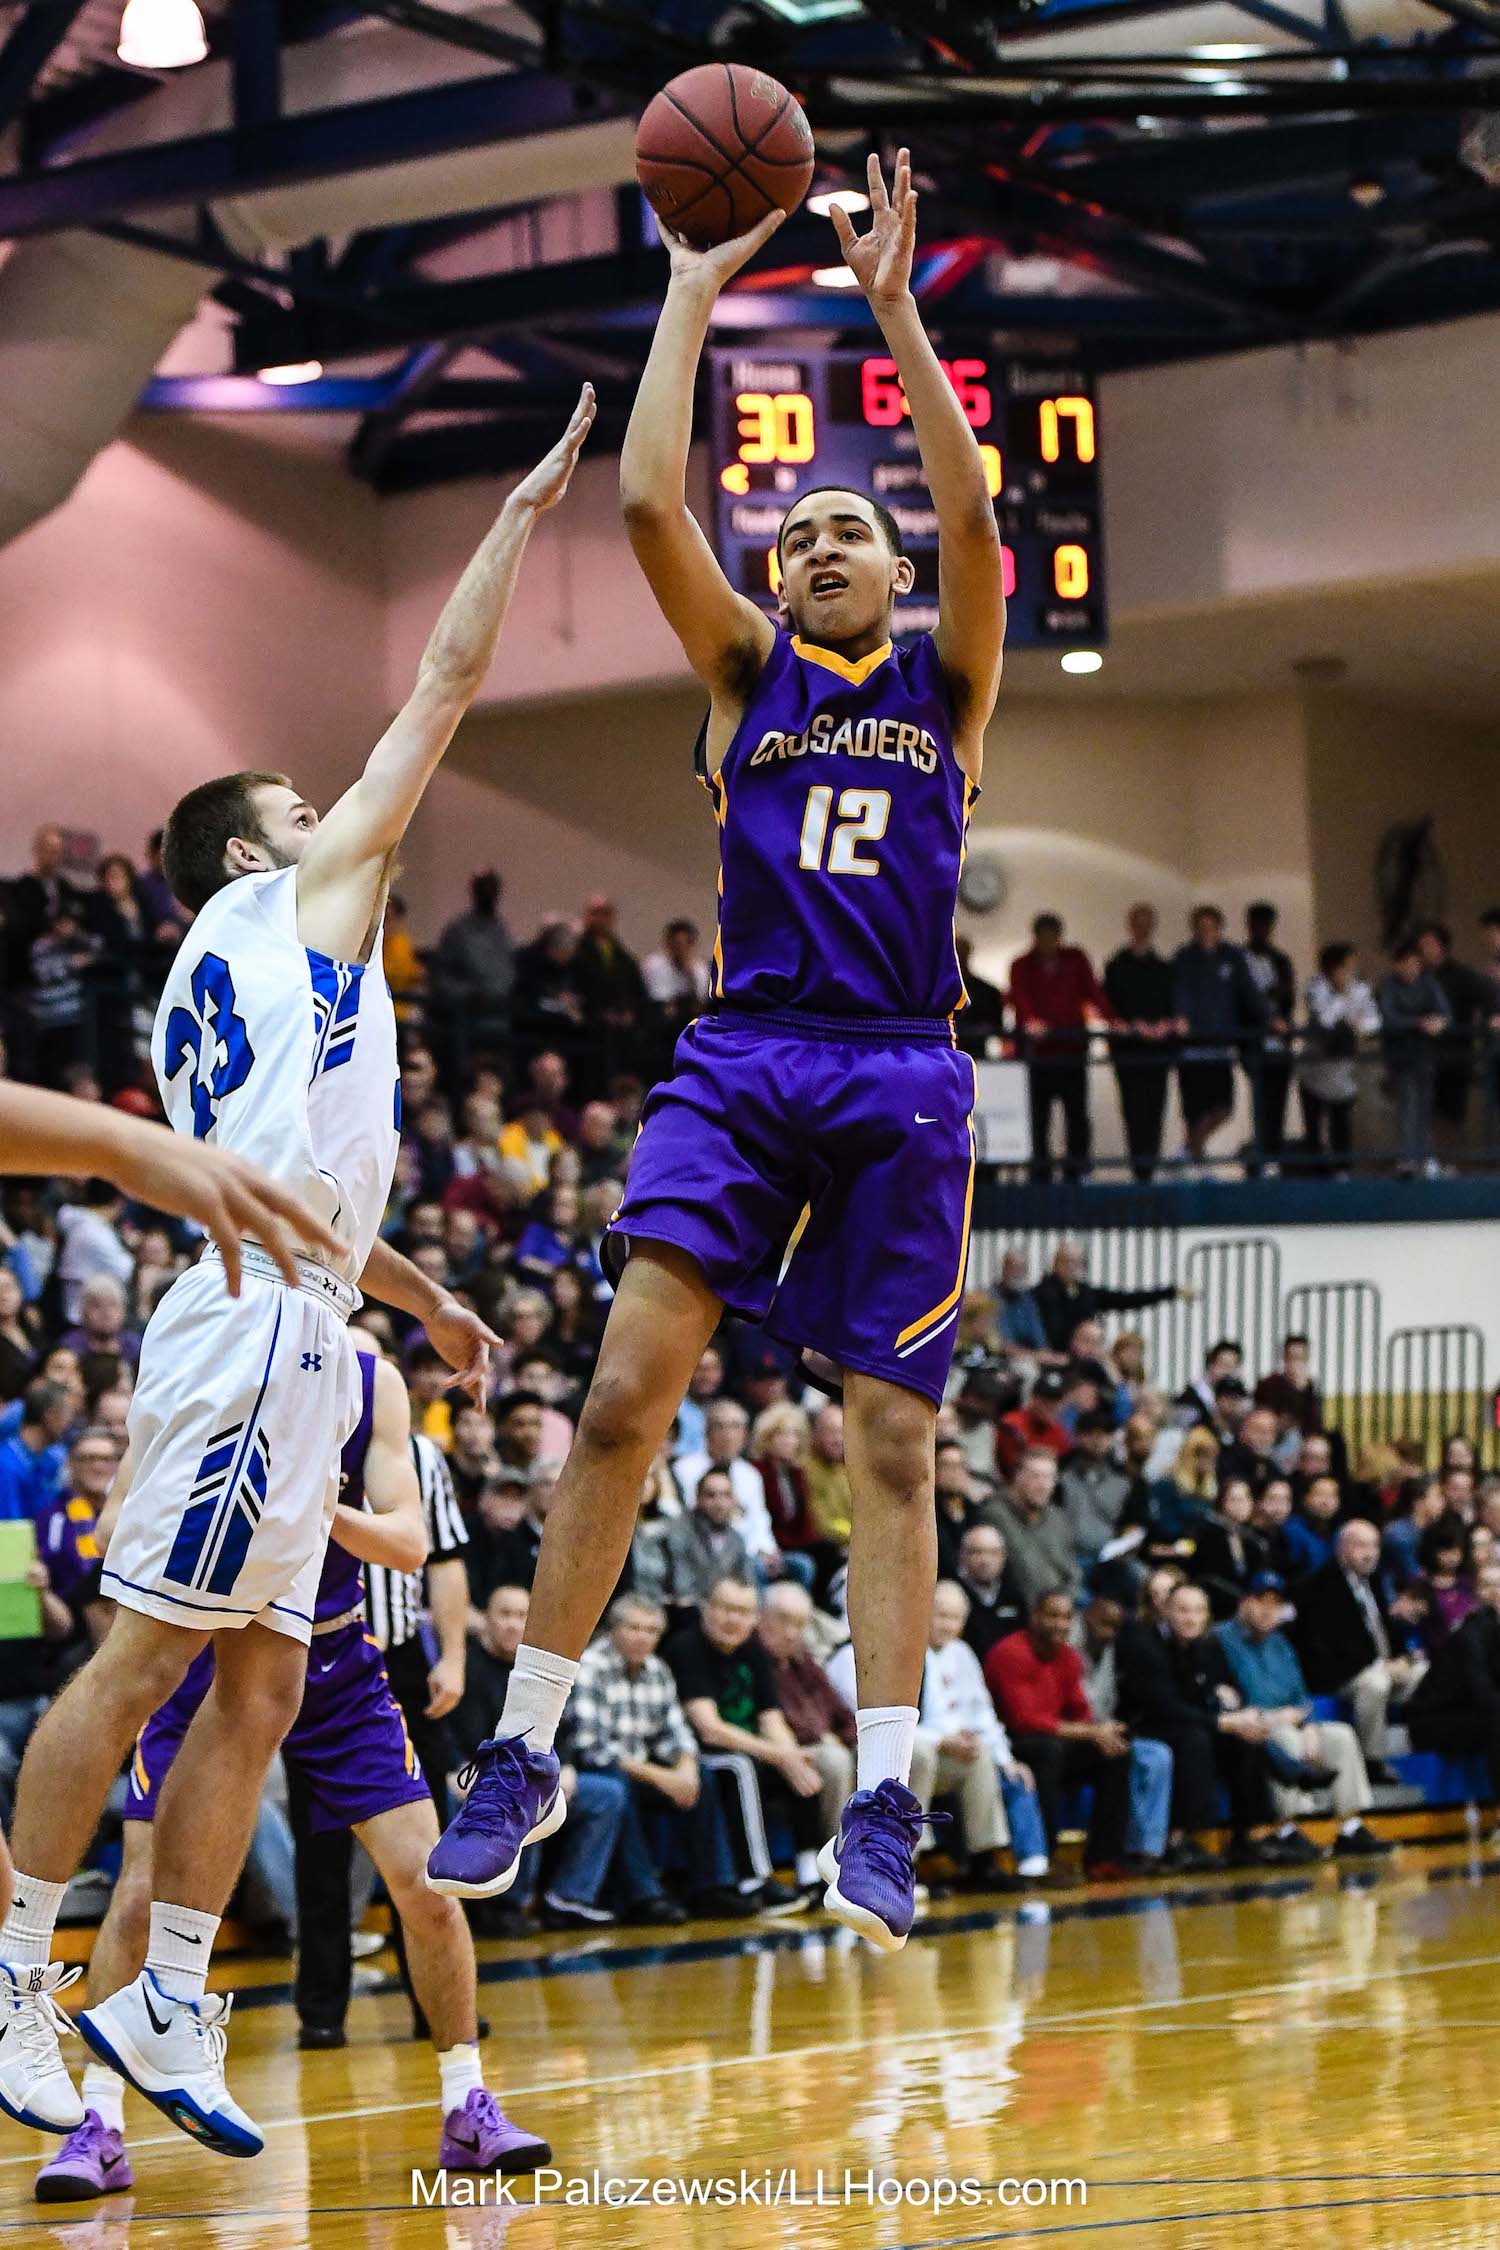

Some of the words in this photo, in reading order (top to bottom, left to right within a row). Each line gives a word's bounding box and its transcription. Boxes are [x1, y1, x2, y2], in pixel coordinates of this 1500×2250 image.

[736, 393, 815, 464] 30
[1040, 397, 1095, 463] 17
[1054, 545, 1088, 599] 0
[750, 714, 939, 775] CRUSADERS
[799, 785, 892, 877] 12
[164, 951, 256, 1143] 23
